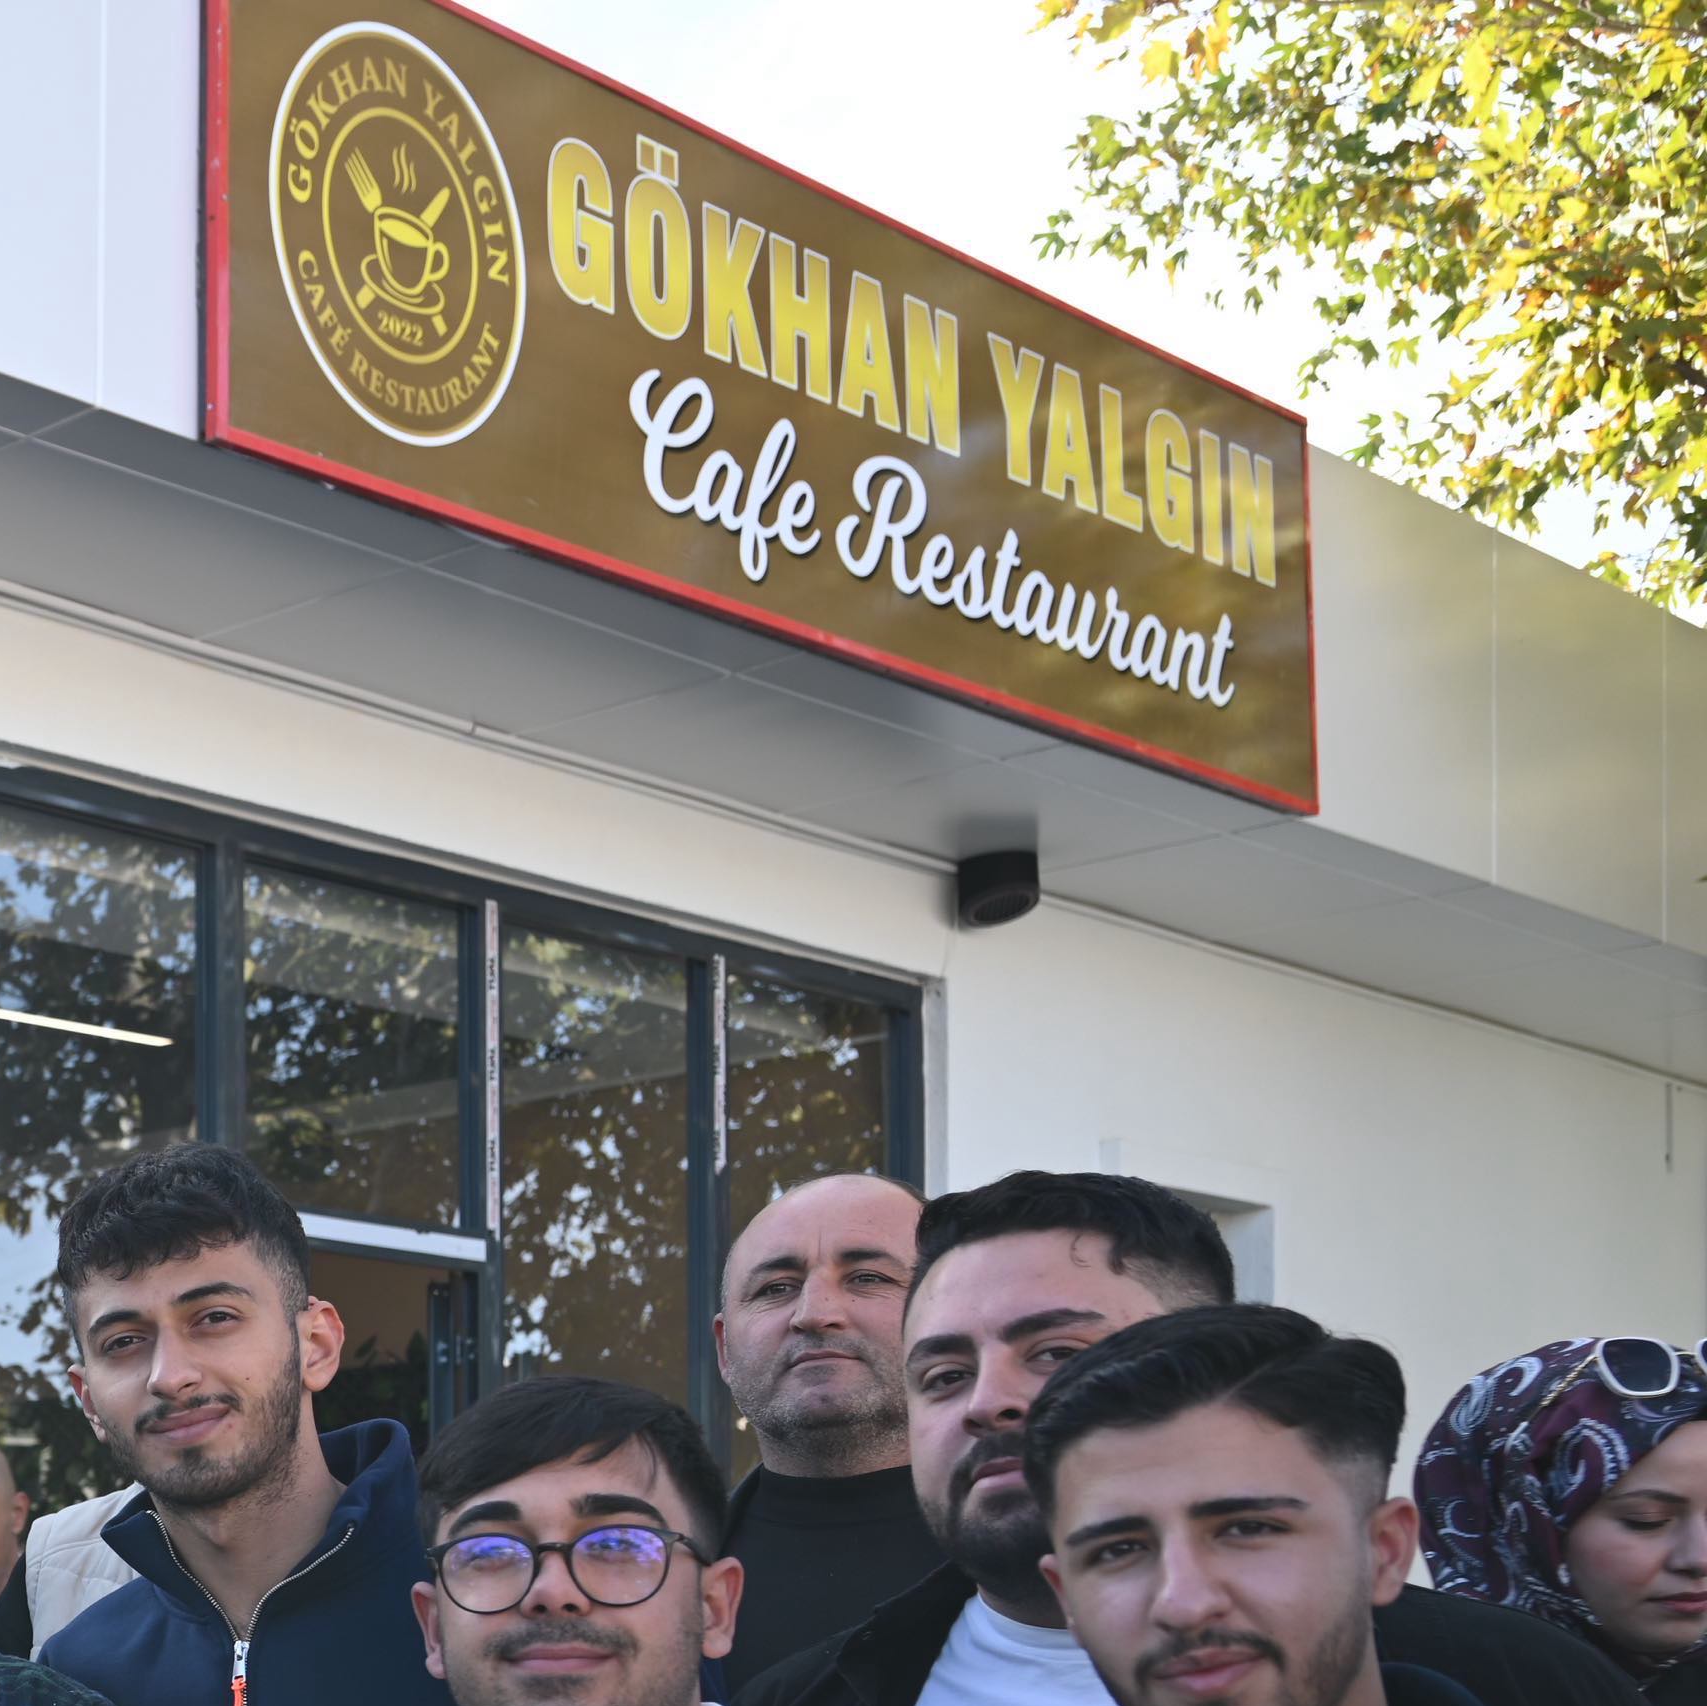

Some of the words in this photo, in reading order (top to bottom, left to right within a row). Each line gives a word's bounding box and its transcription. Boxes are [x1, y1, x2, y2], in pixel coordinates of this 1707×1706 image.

[288, 57, 409, 204] GÖKHAN
[421, 78, 511, 289] YALGIN
[348, 322, 502, 416] RESTAURANT
[377, 310, 424, 346] 2022
[548, 133, 962, 458] GÖKHAN
[987, 331, 1277, 588] YALGIN
[629, 368, 822, 584] Cafe
[835, 454, 1235, 708] Restaurant
